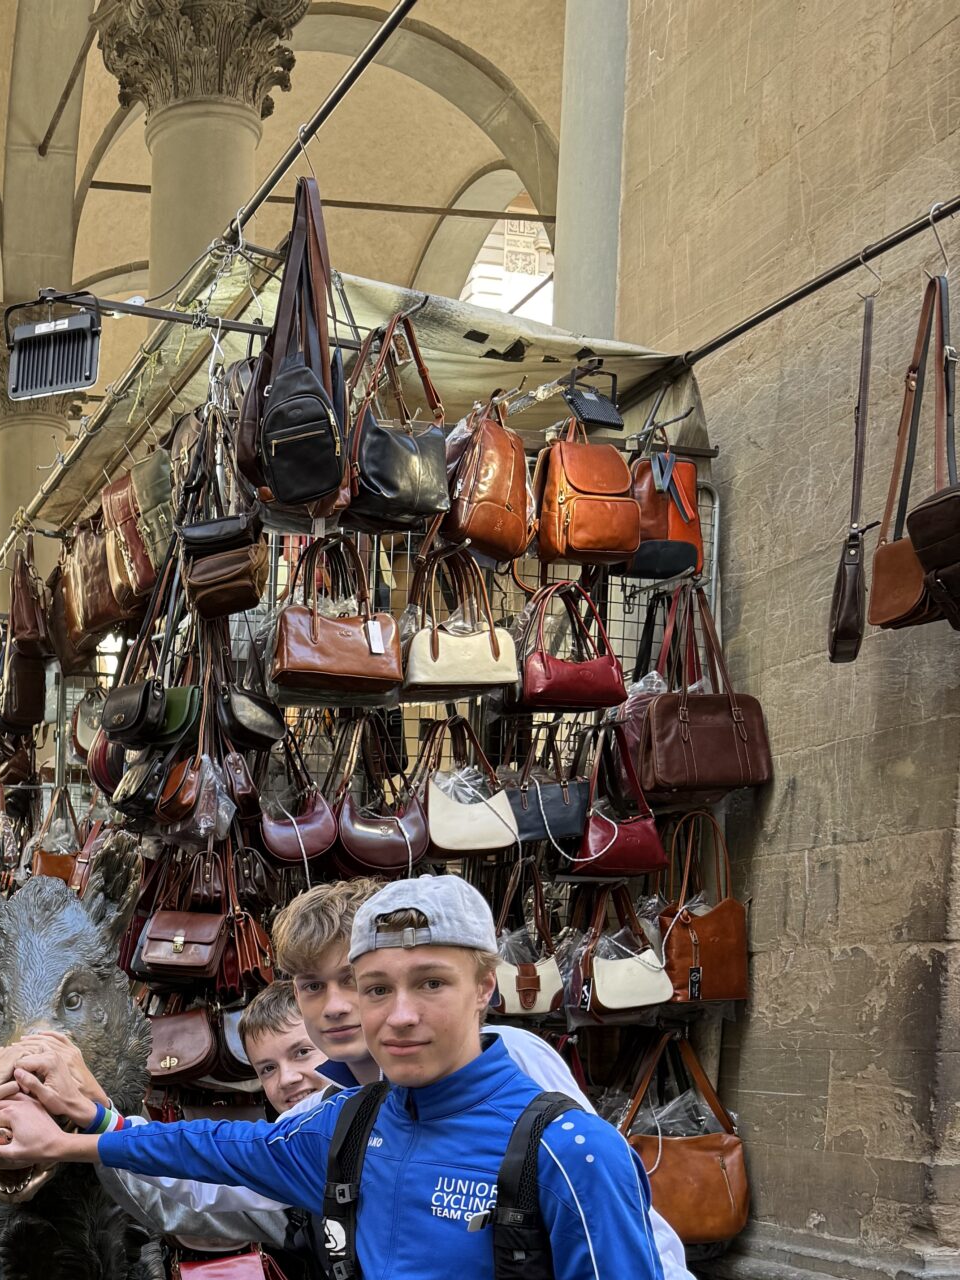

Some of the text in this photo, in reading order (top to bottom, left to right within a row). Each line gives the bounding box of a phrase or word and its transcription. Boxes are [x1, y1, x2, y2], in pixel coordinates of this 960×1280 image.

[435, 1176, 498, 1198] JUNIOR
[431, 1191, 497, 1212] CYCLING
[431, 1206, 462, 1220] TEAM
